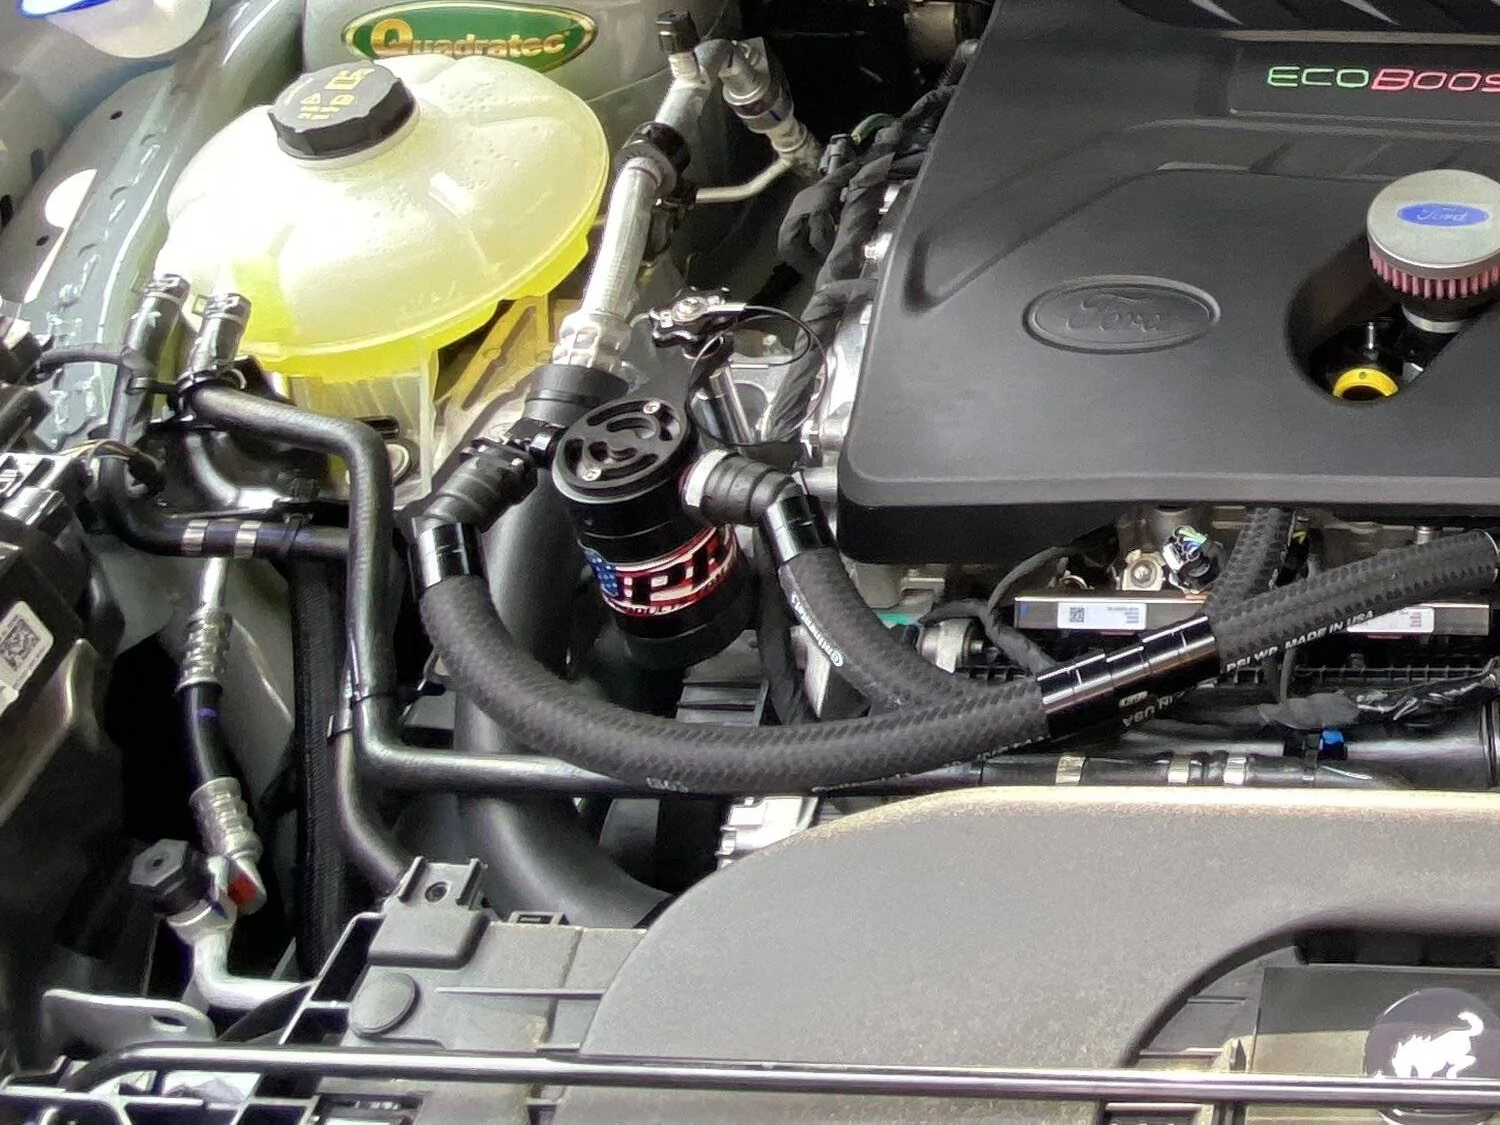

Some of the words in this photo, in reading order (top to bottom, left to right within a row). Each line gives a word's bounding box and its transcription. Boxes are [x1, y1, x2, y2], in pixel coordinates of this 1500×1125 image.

[370, 18, 568, 58] Quadratec
[1416, 207, 1470, 222] Ford
[1284, 627, 1328, 650] MADE
[1328, 621, 1344, 634] IN
